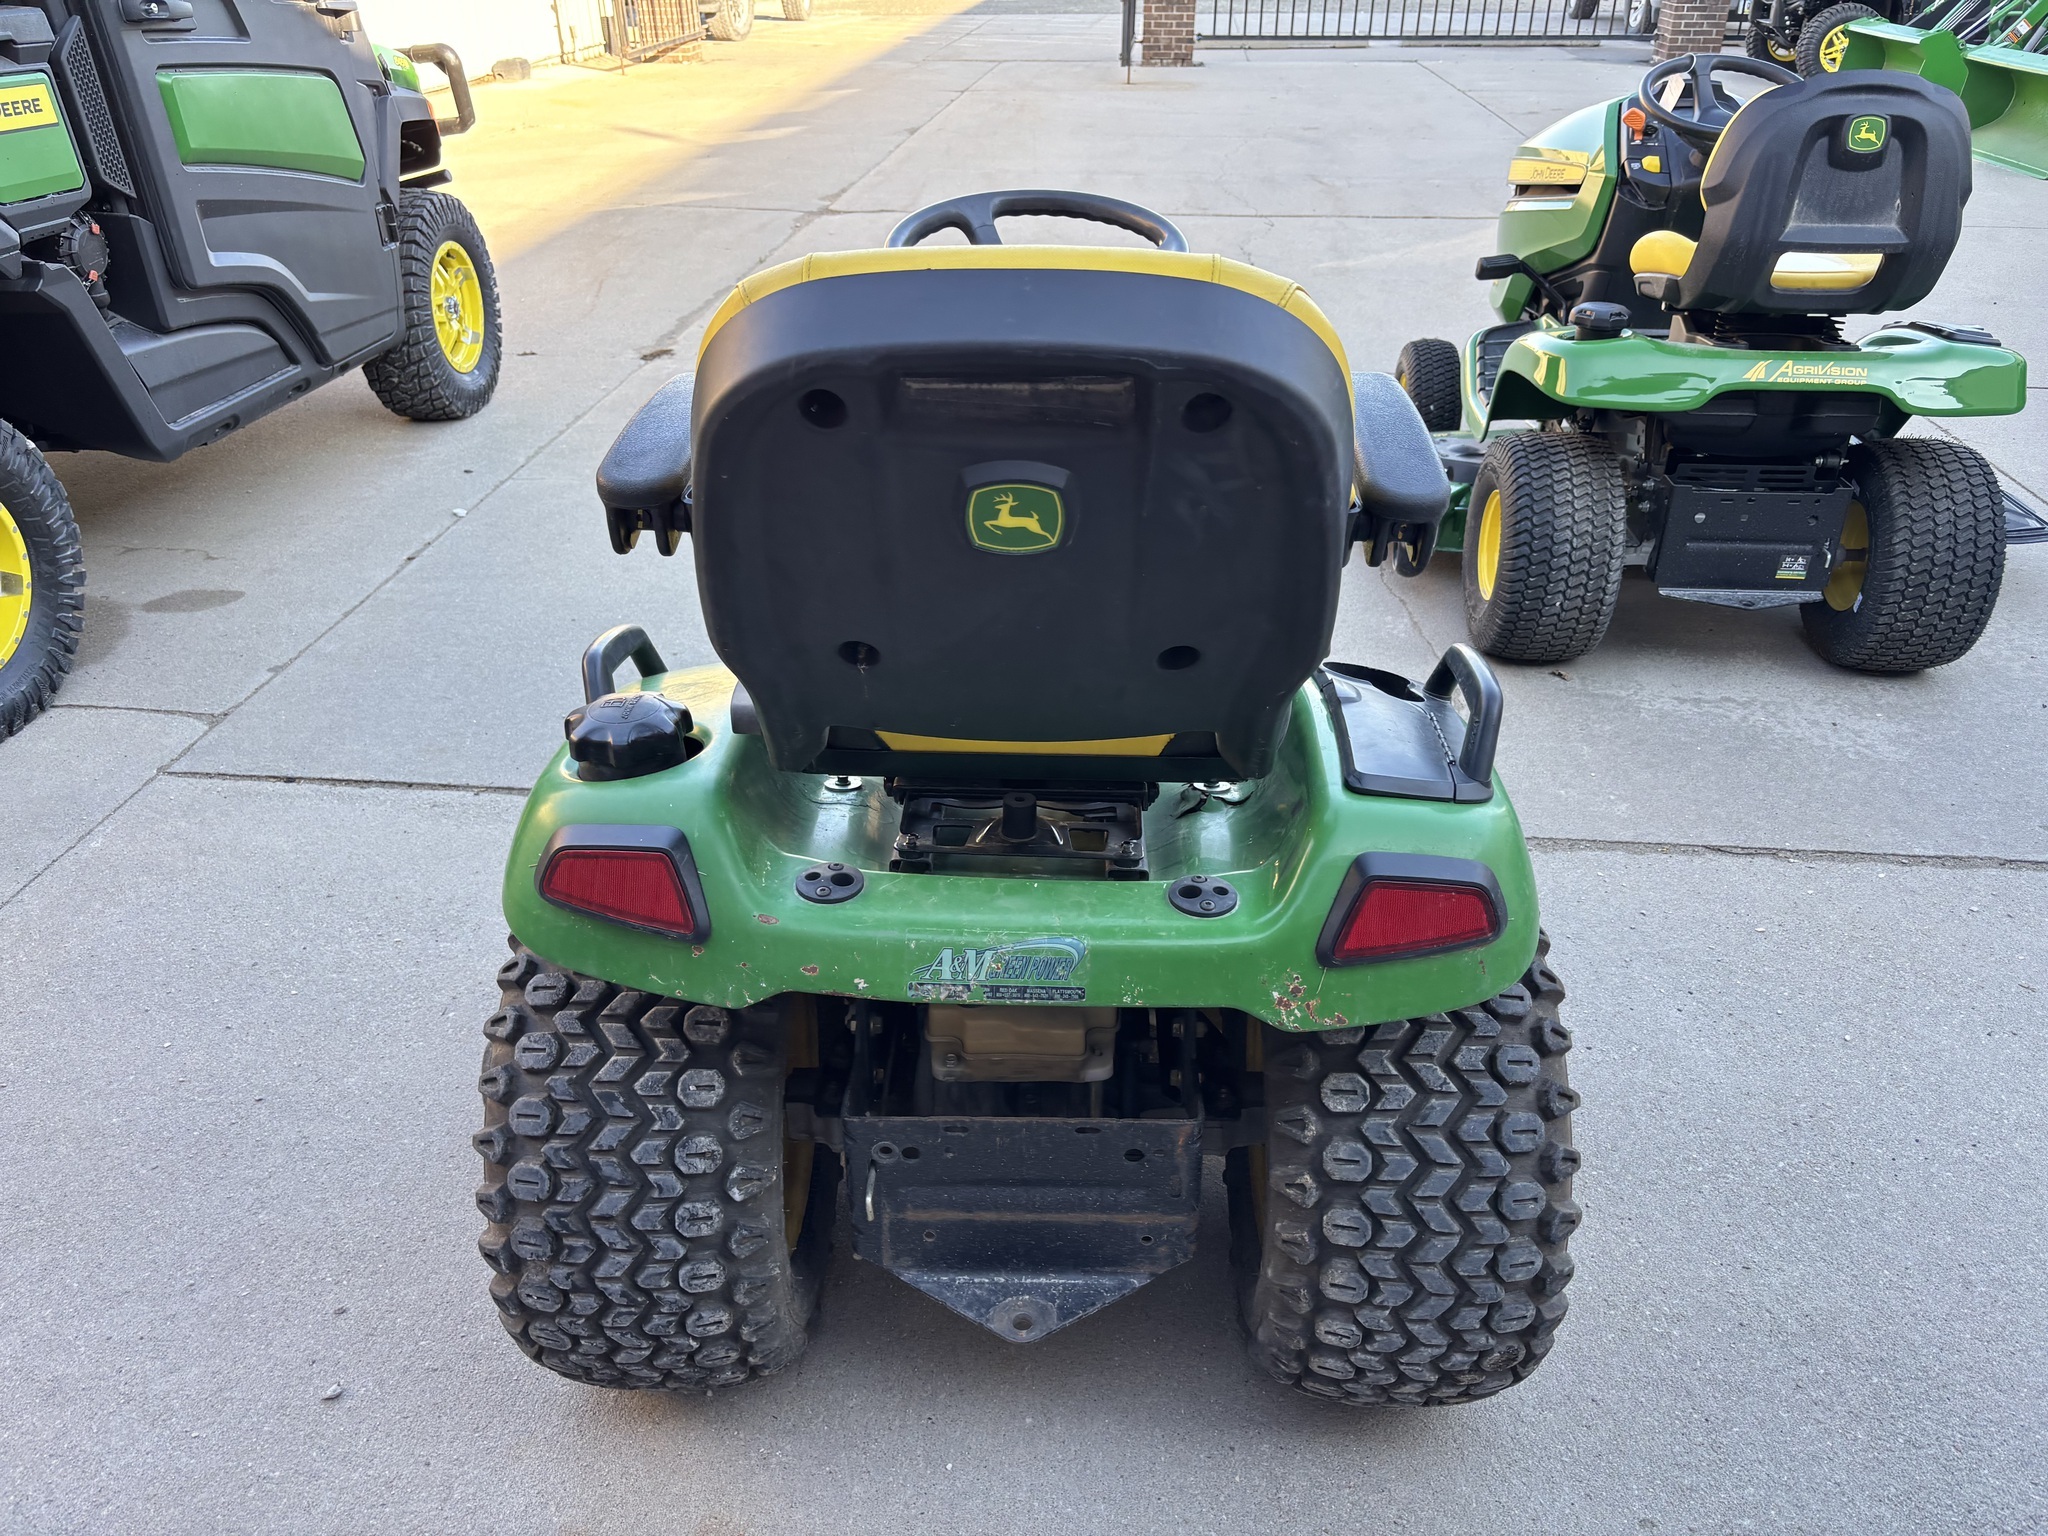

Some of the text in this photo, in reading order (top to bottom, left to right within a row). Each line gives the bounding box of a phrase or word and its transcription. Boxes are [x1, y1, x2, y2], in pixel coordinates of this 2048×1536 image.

[1530, 167, 1566, 180] JOHN DEERE
[1777, 377, 1833, 385] EQUIPMENT
[919, 947, 997, 981] A&M
[1028, 956, 1074, 981] POWER
